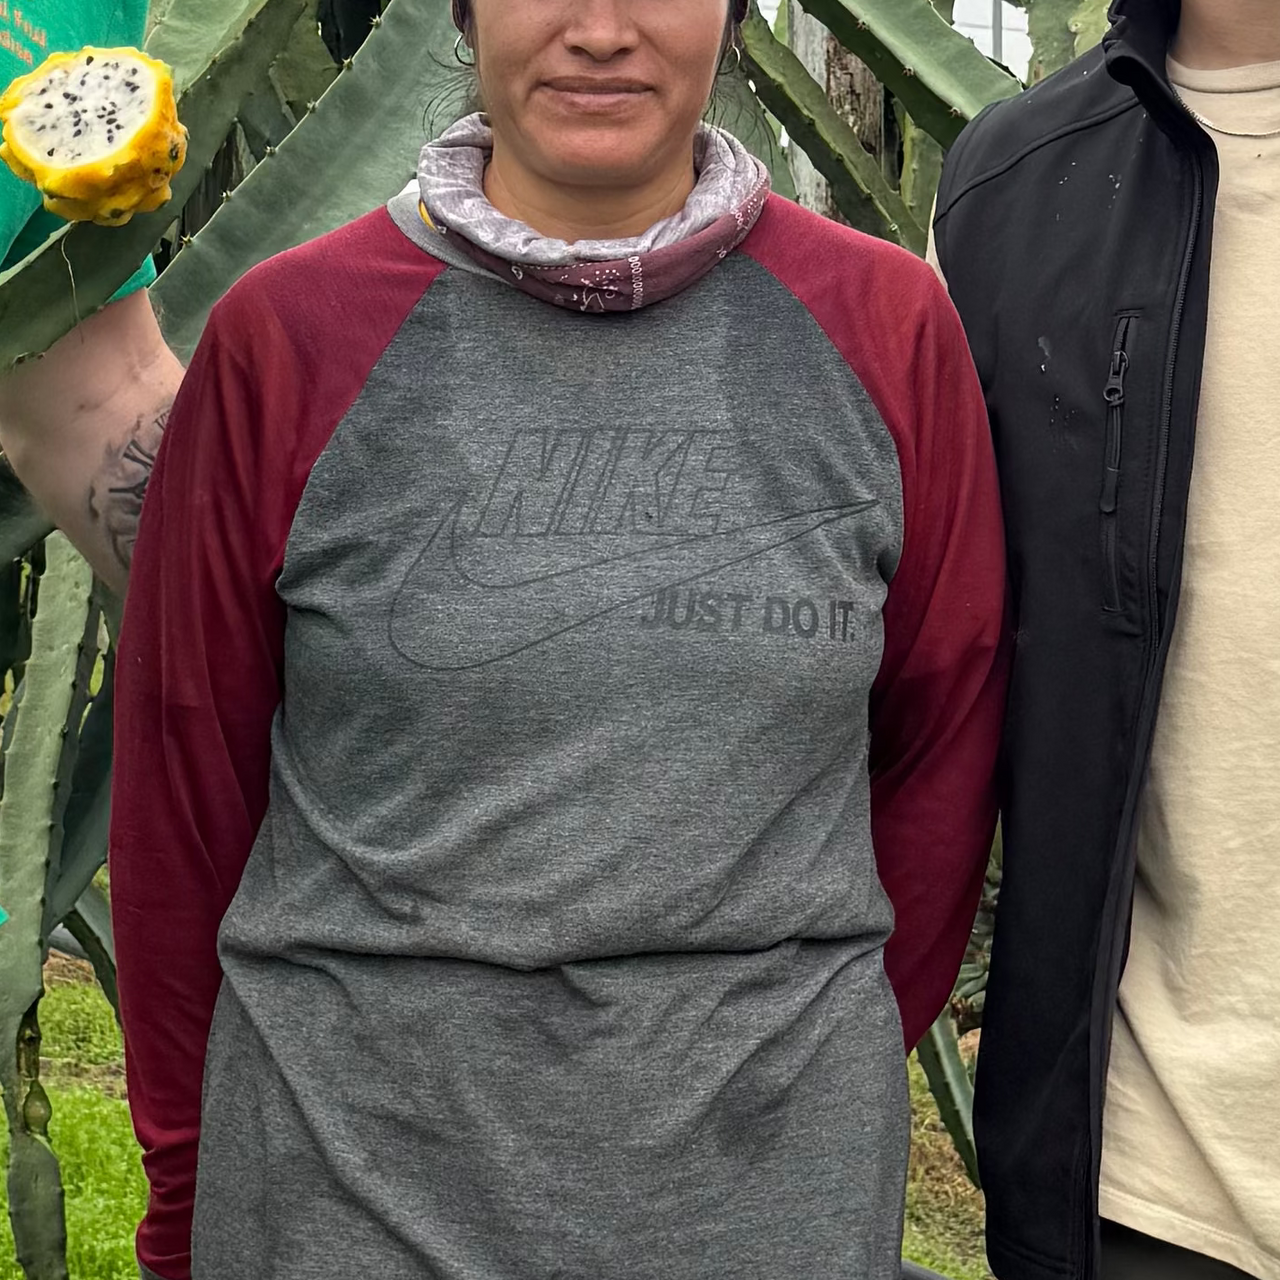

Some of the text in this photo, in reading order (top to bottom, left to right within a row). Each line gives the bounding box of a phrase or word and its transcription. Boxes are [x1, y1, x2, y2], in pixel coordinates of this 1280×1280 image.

[475, 426, 742, 537] NIKE
[640, 587, 754, 635] JUST
[763, 595, 820, 639] DO
